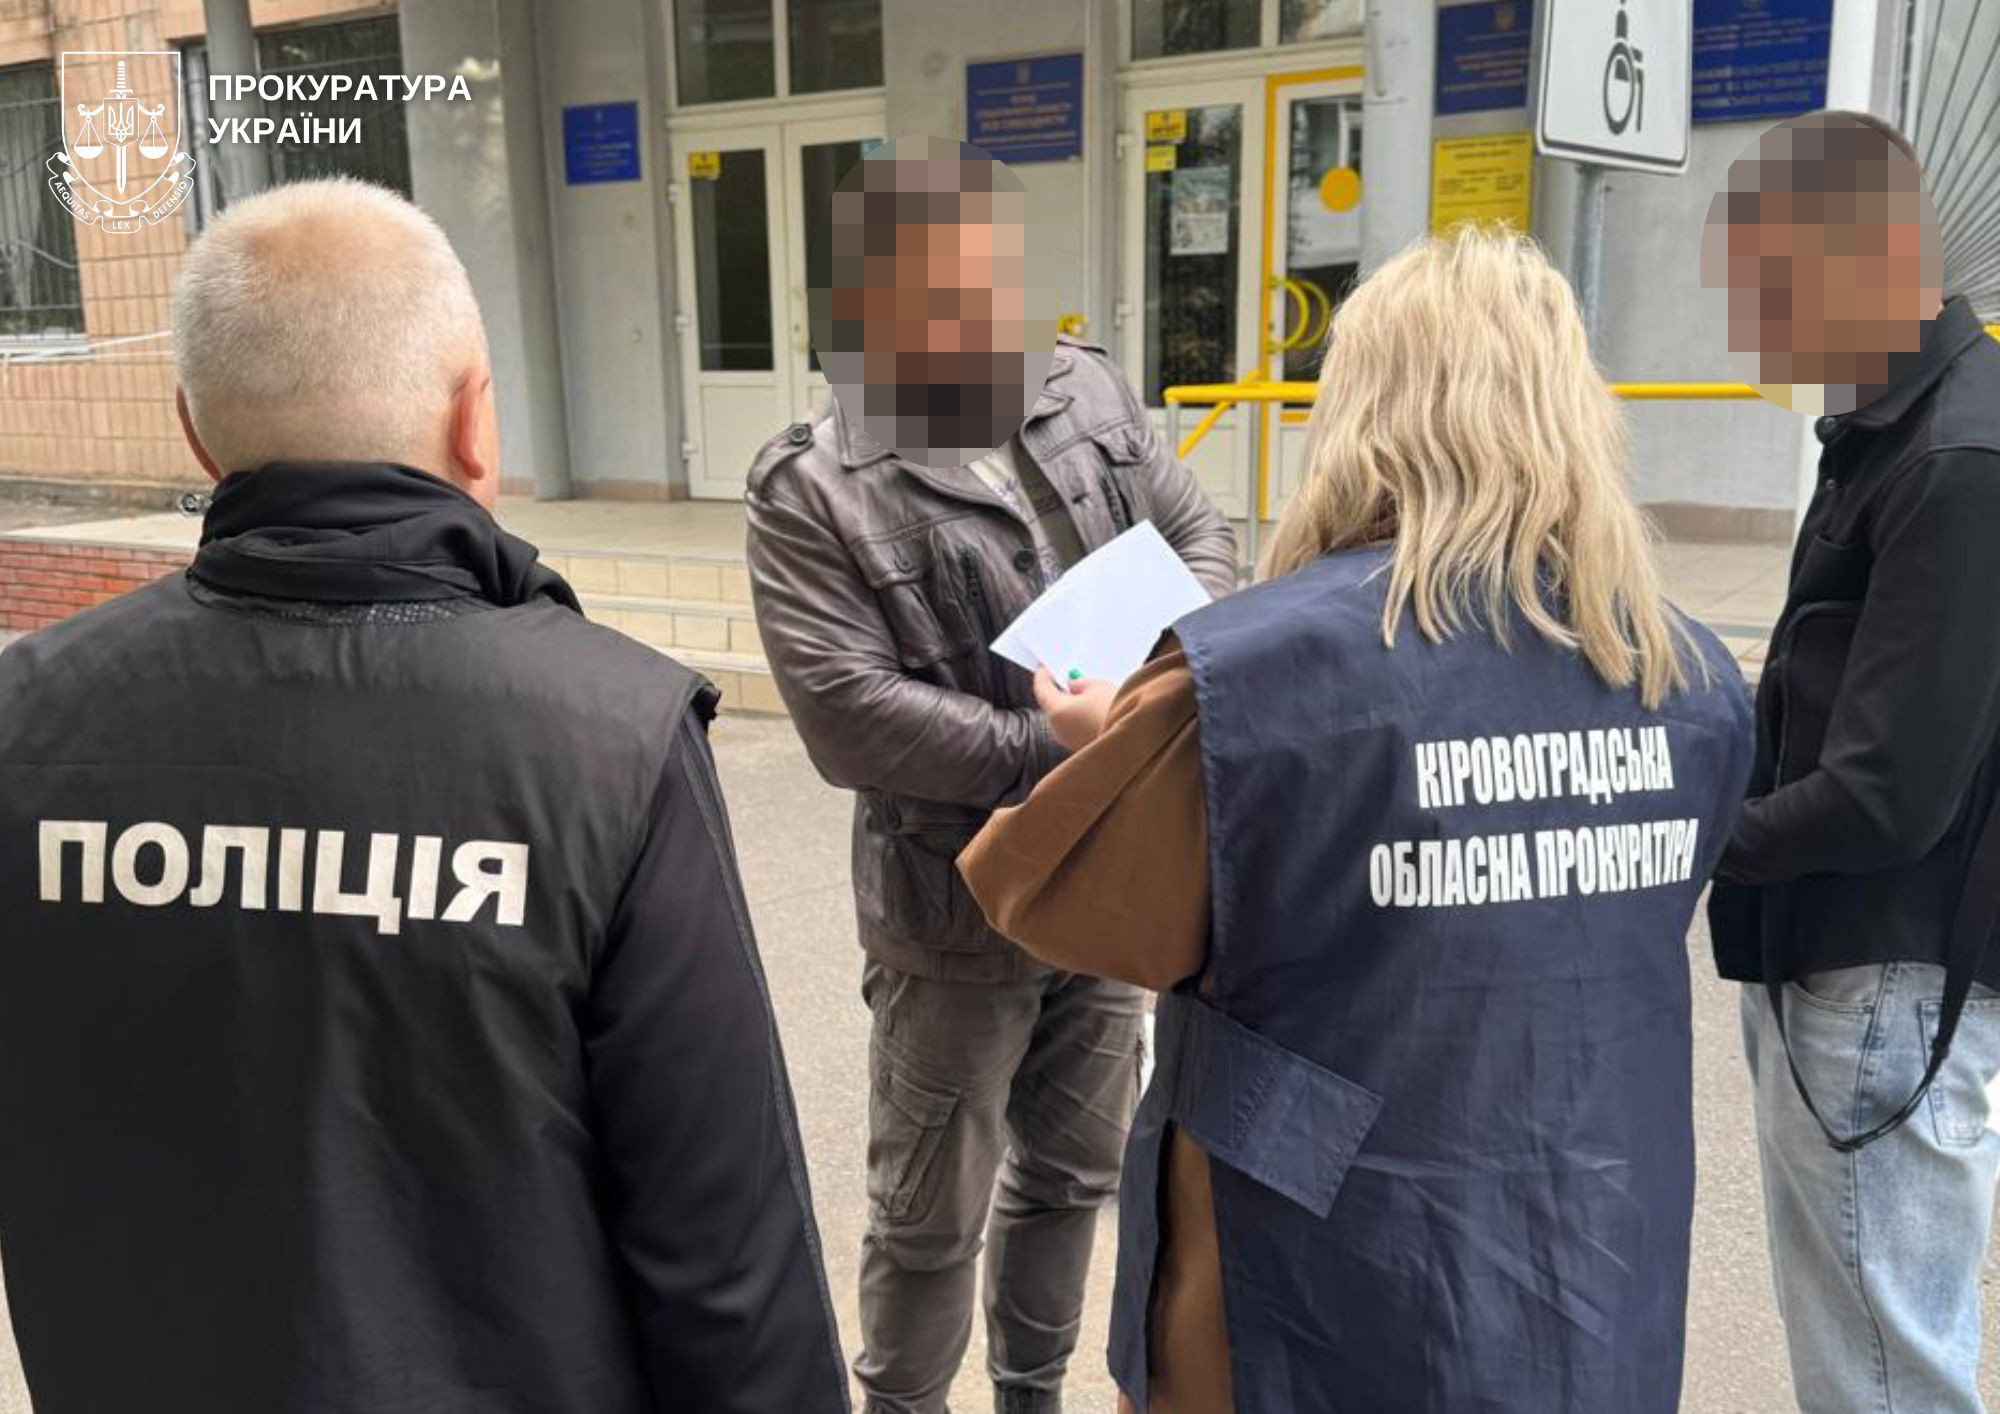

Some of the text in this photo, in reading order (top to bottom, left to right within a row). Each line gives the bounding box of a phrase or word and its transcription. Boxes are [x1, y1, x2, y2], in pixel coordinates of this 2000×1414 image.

[1415, 726, 1675, 808] КІРОВОГРАДСЬКА
[38, 820, 530, 935] ПОЛІЦІЯ
[1370, 818, 1699, 907] ОБЛАСНА ПРОКУРАТУРА
